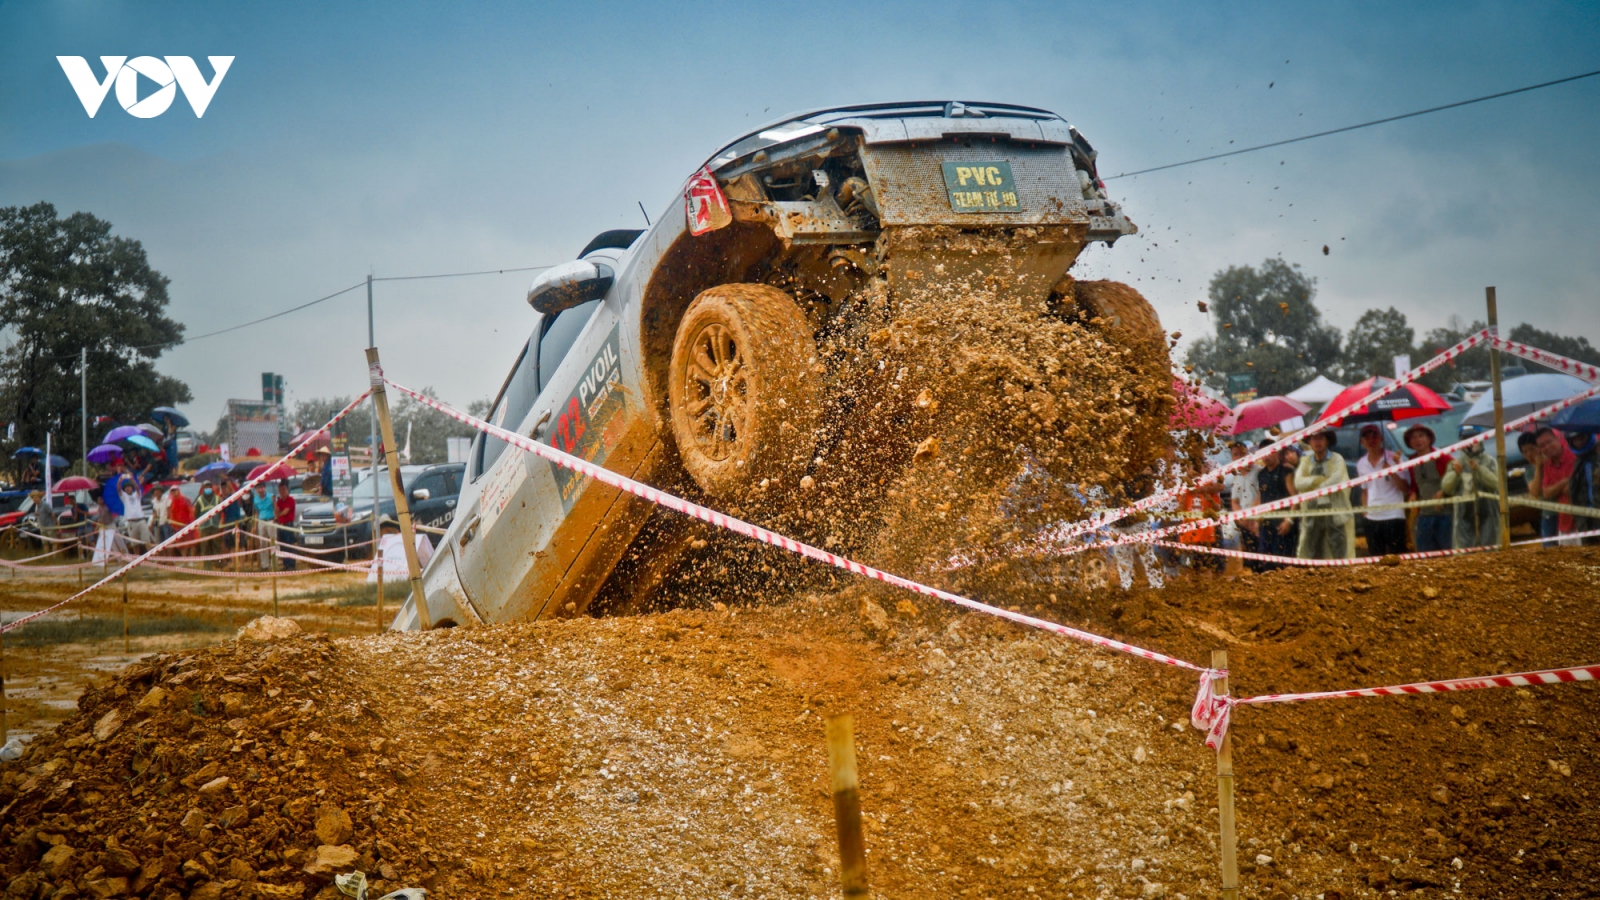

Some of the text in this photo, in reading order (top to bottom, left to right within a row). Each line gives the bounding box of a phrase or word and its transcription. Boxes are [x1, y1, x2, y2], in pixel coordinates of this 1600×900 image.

[956, 166, 1002, 186] PVC
[953, 191, 984, 208] TEAM
[579, 342, 617, 408] PVOIL
